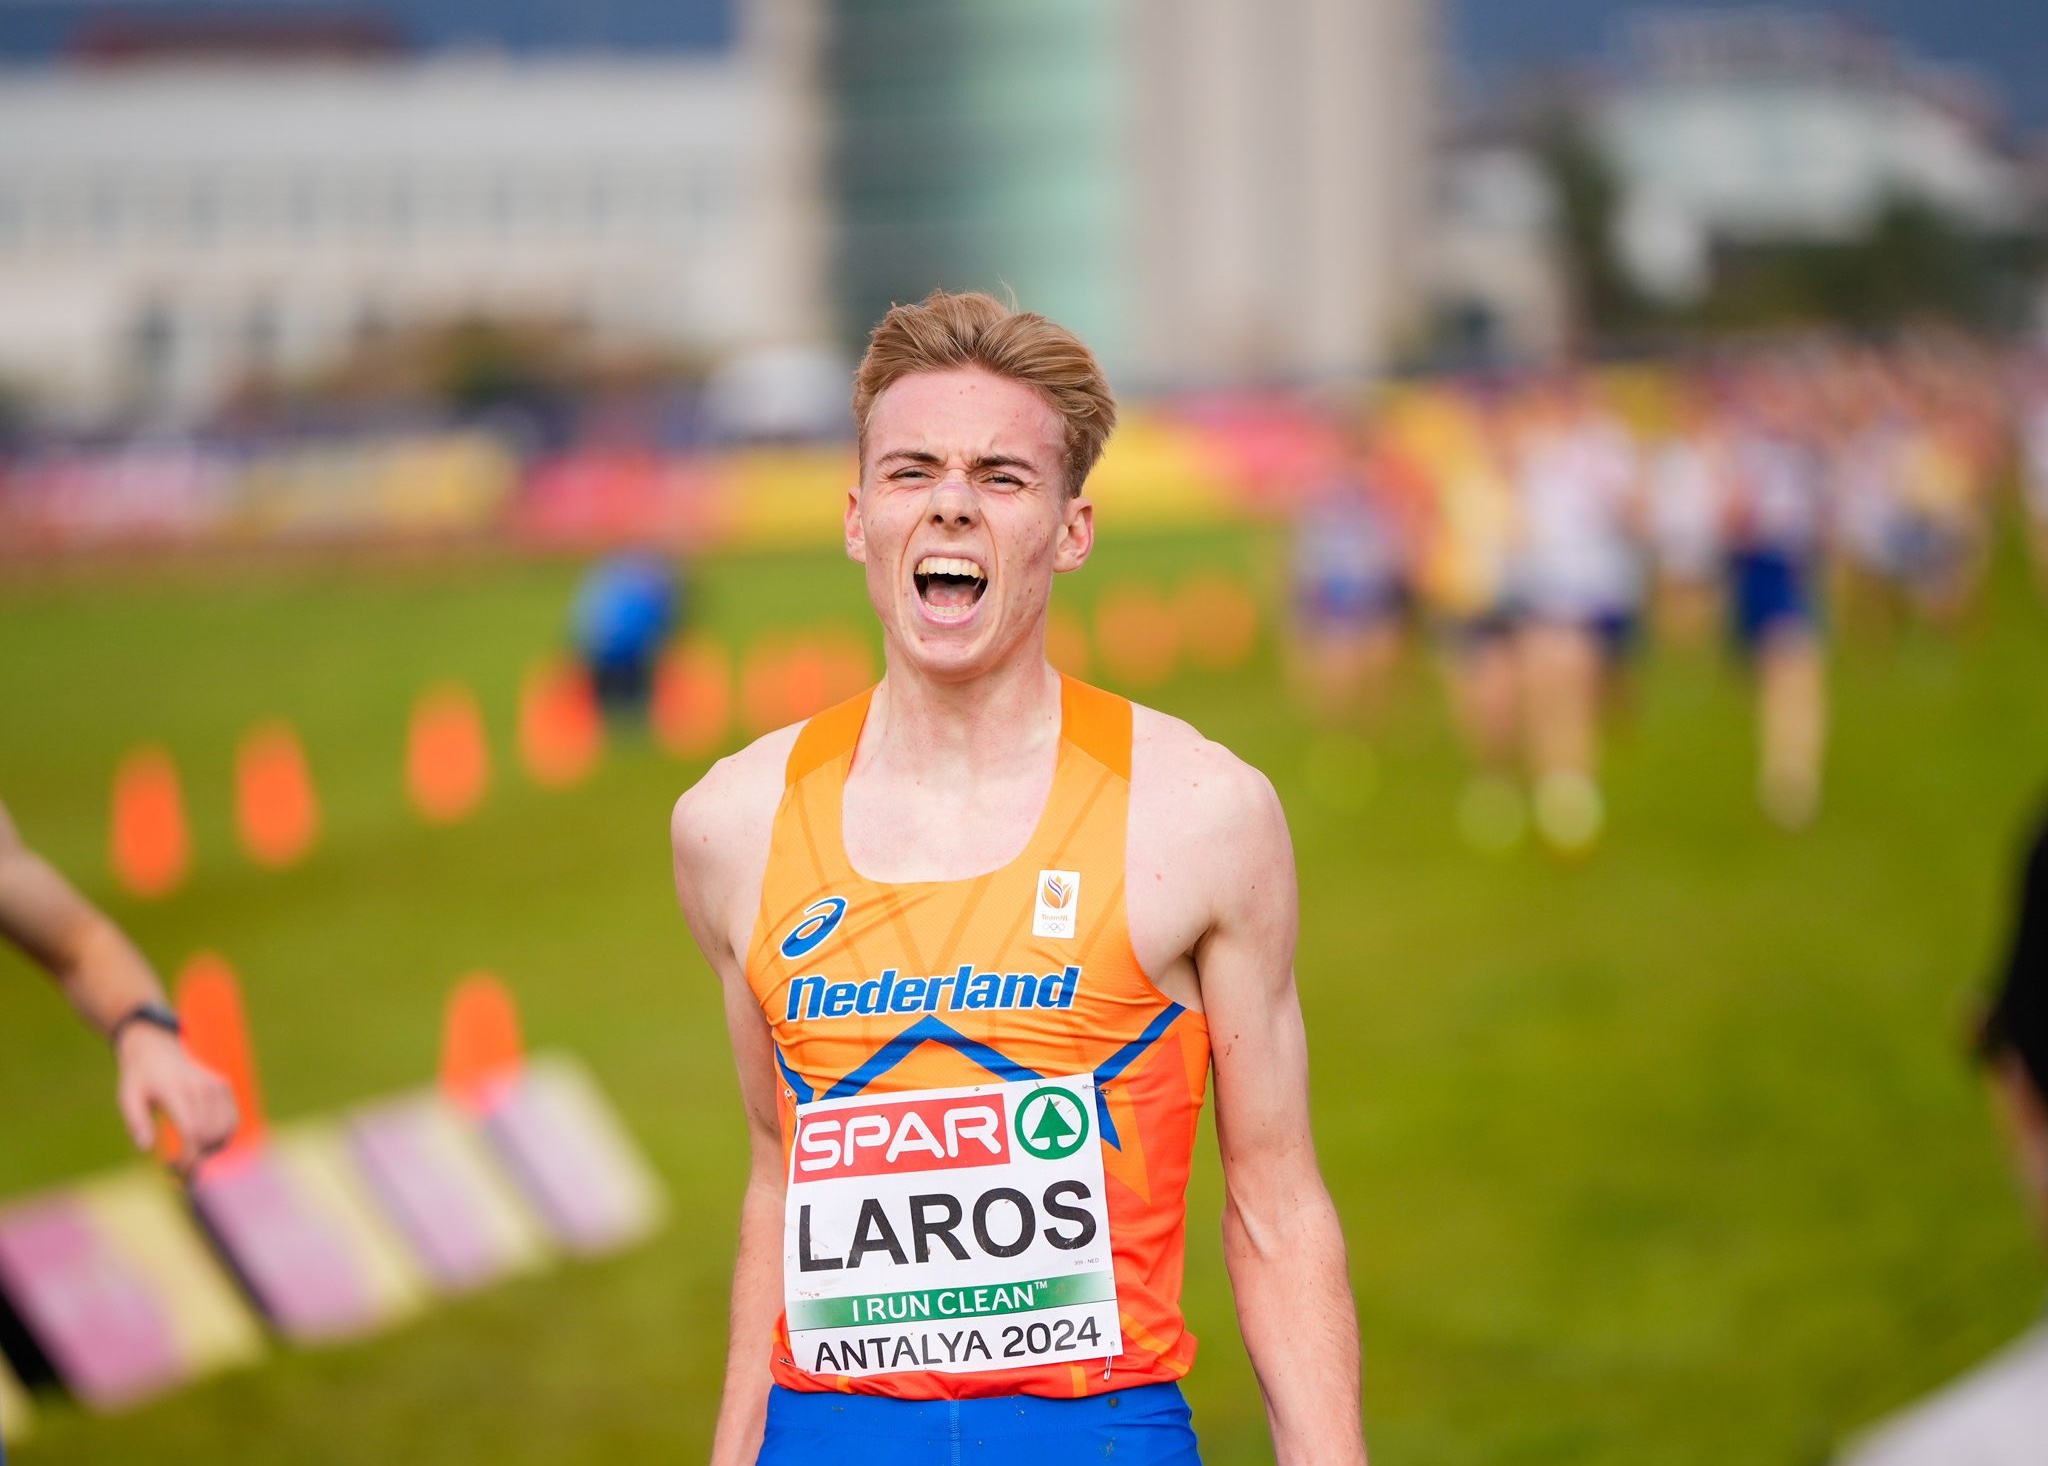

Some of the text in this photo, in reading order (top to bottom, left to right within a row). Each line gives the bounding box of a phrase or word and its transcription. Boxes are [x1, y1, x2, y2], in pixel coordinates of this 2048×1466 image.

[786, 963, 1082, 1021] Nederland
[800, 1105, 1002, 1172] SPAR
[799, 1180, 1097, 1273] LAROS
[852, 1299, 860, 1322] I
[866, 1293, 931, 1321] RUN
[815, 1316, 1102, 1372] ANTALYA 2024
